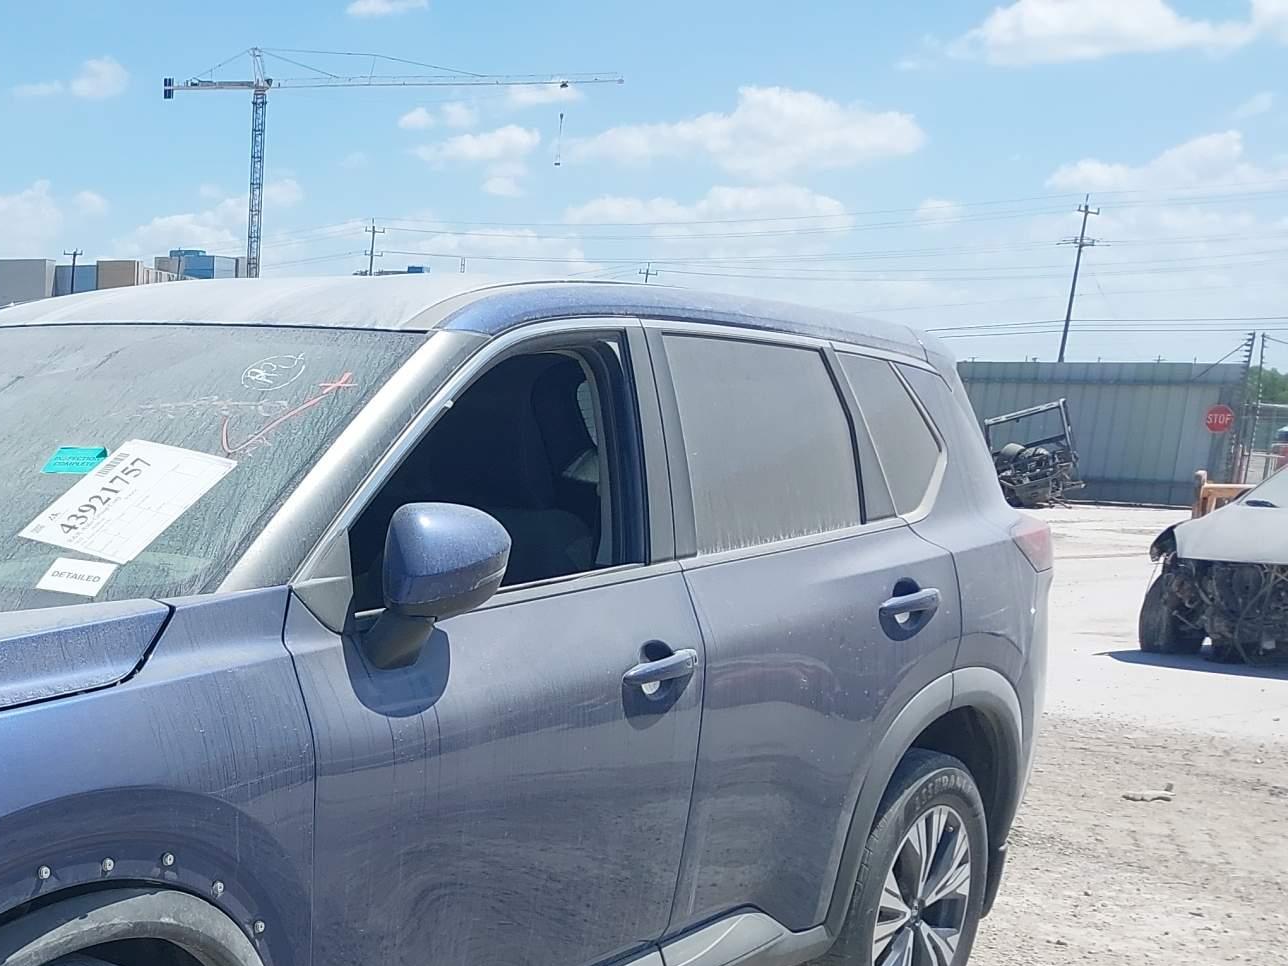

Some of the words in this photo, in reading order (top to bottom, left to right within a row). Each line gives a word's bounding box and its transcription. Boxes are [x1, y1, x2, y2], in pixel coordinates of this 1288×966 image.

[1207, 413, 1232, 425] STOP
[60, 457, 151, 534] 43921757
[51, 570, 101, 583] DETAILED
